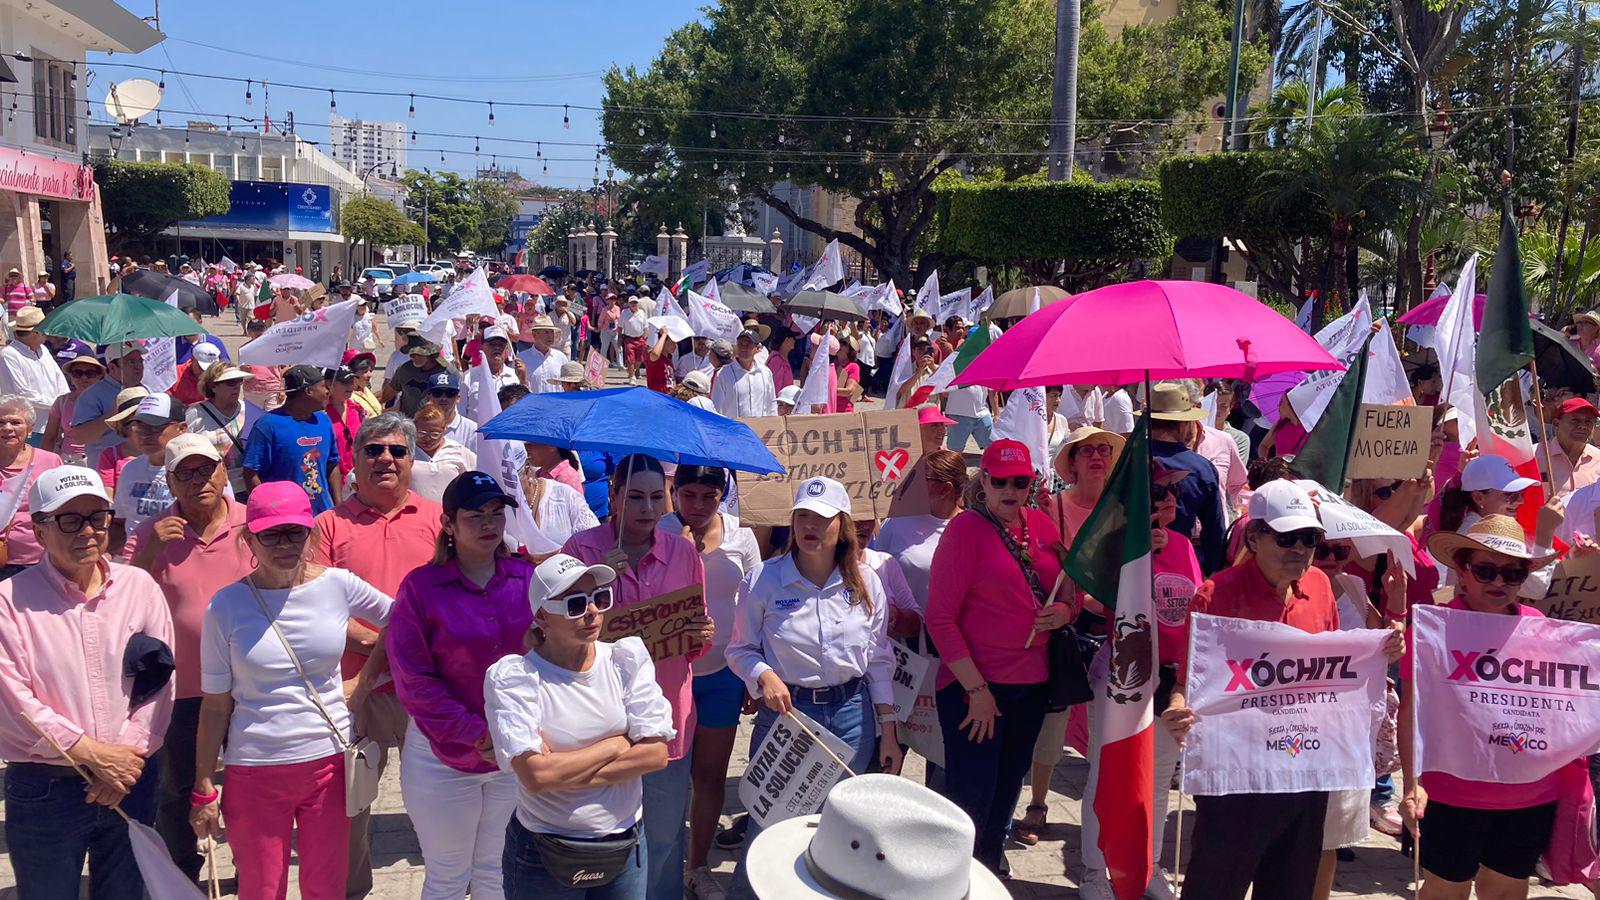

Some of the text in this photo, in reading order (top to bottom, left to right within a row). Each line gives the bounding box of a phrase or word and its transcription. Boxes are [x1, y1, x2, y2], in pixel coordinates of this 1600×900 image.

[0, 160, 40, 191] cialmente
[1366, 410, 1410, 429] FUERA
[1354, 438, 1418, 458] MORENA
[1335, 523, 1347, 533] LA
[1224, 652, 1358, 692] XÓCHITL
[1446, 649, 1600, 691] XÓCHITL
[1240, 691, 1338, 709] PRESIDENTA
[1469, 691, 1576, 712] PRESIDENTA
[1272, 707, 1308, 716] CANDIDATA
[1502, 708, 1540, 718] CANDIDATA
[747, 723, 792, 789] VOTAR ES
[785, 796, 800, 813] ESTE
[798, 782, 810, 794] DE
[806, 761, 824, 784] JUNIO
[819, 779, 827, 791] EN
[823, 770, 834, 782] TU
[753, 795, 773, 819] LA
[573, 869, 604, 884] Guess
